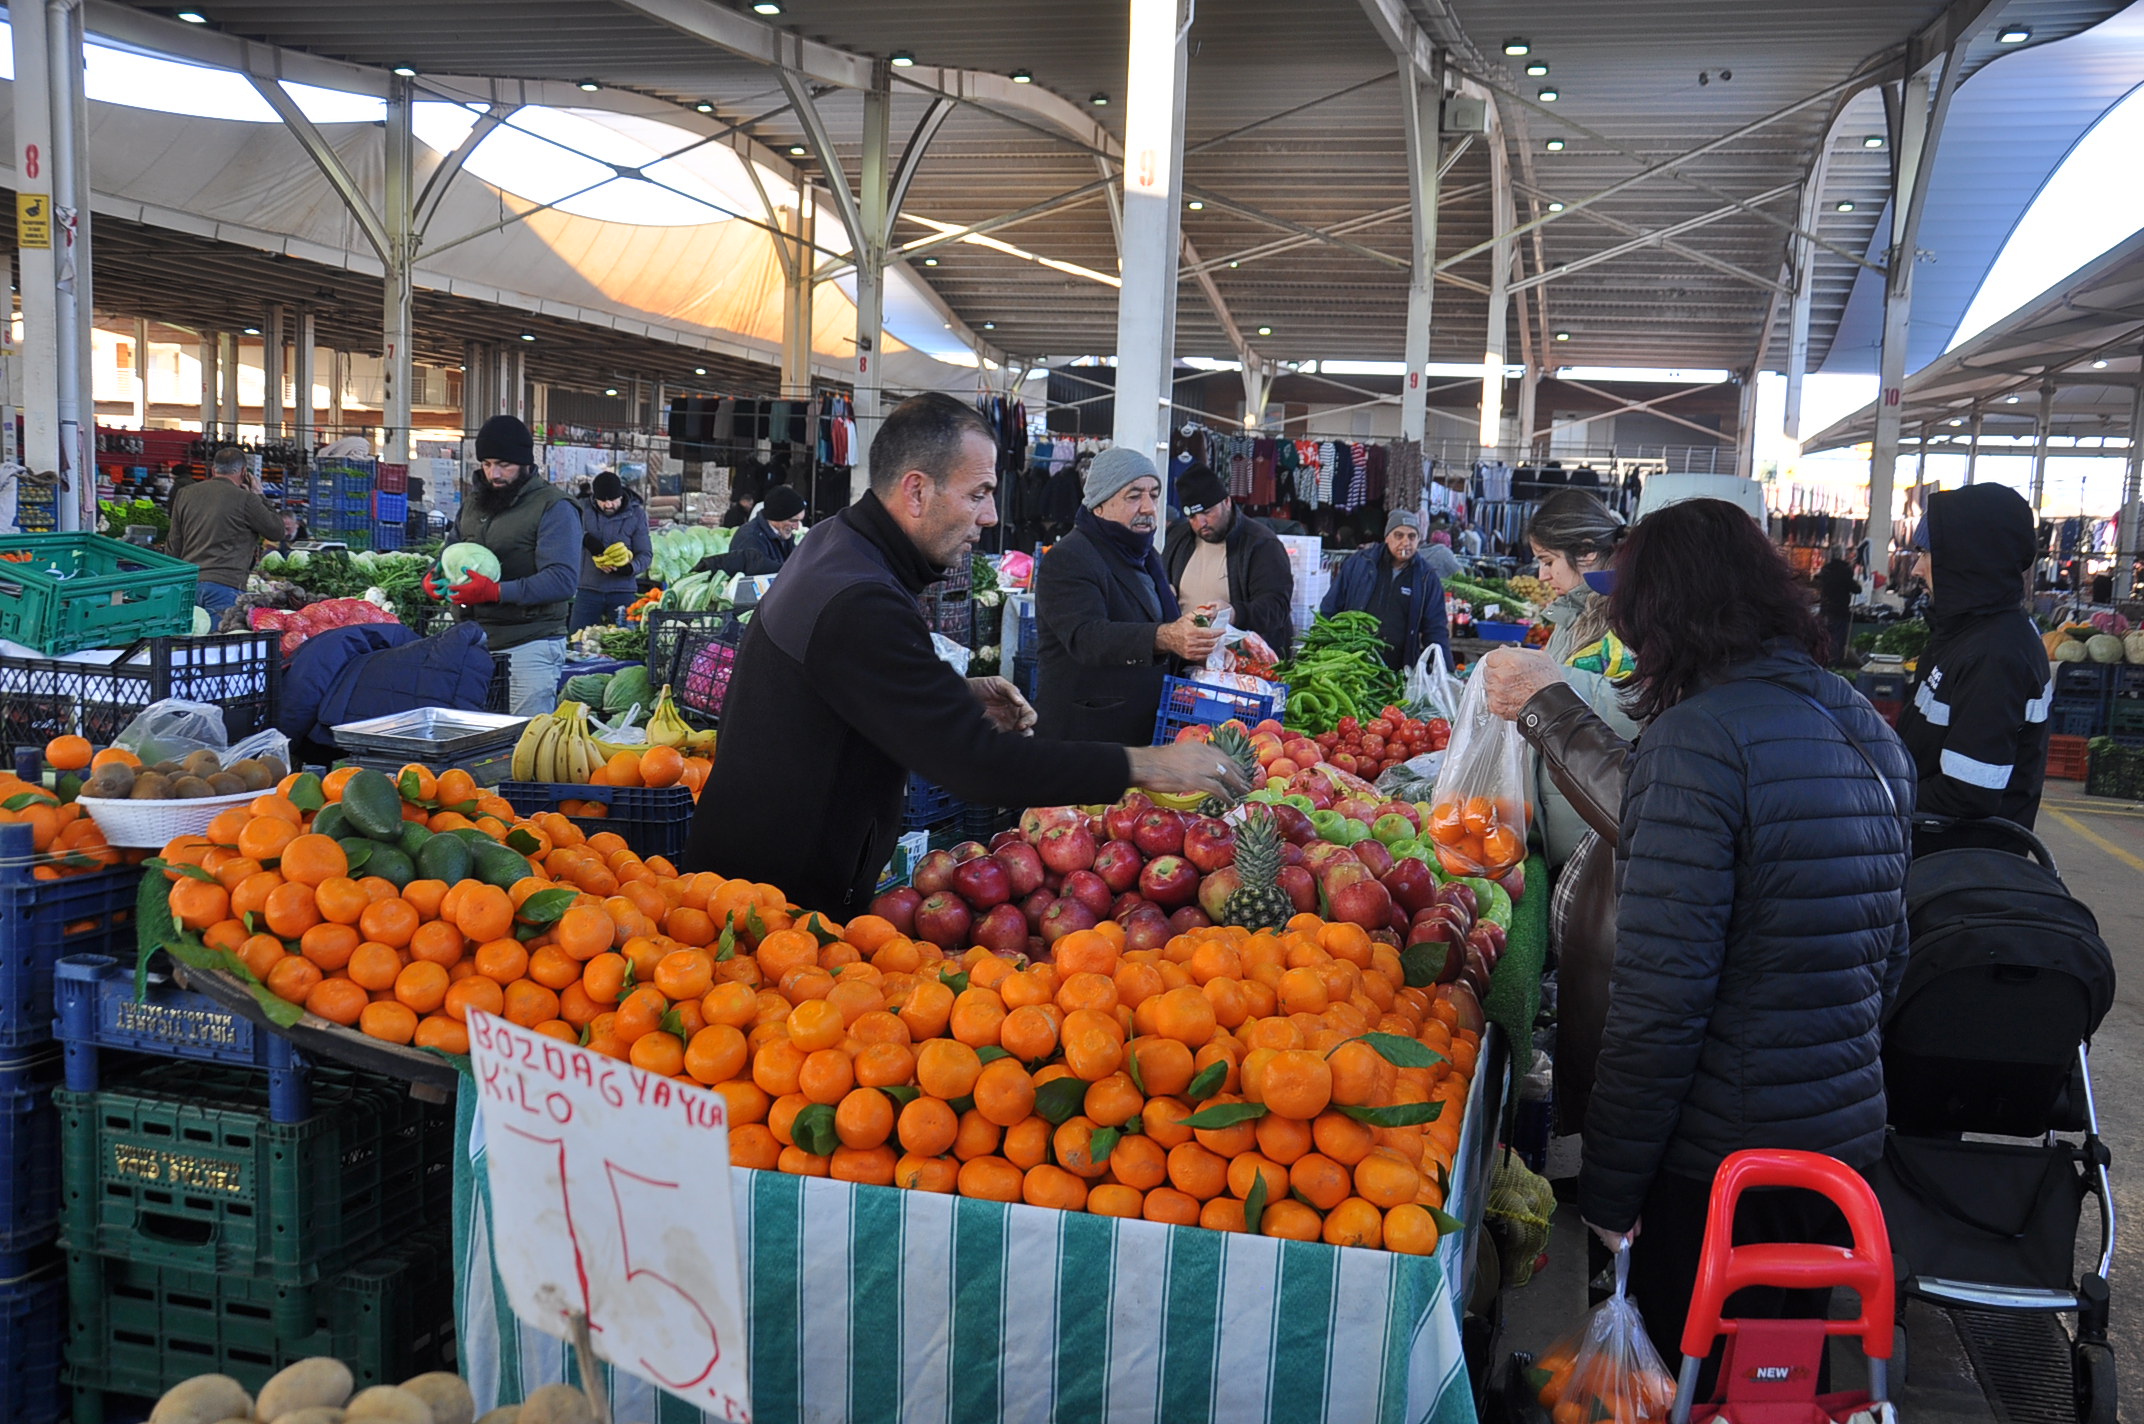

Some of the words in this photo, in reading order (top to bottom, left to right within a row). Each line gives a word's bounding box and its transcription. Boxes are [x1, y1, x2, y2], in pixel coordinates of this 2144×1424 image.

[25, 144, 39, 179] 8
[1139, 150, 1154, 187] 9
[387, 344, 394, 359] 7
[860, 356, 867, 373] 8
[1410, 372, 1418, 389] 9
[1884, 388, 1900, 407] 10
[1756, 1367, 1789, 1378] NEW
